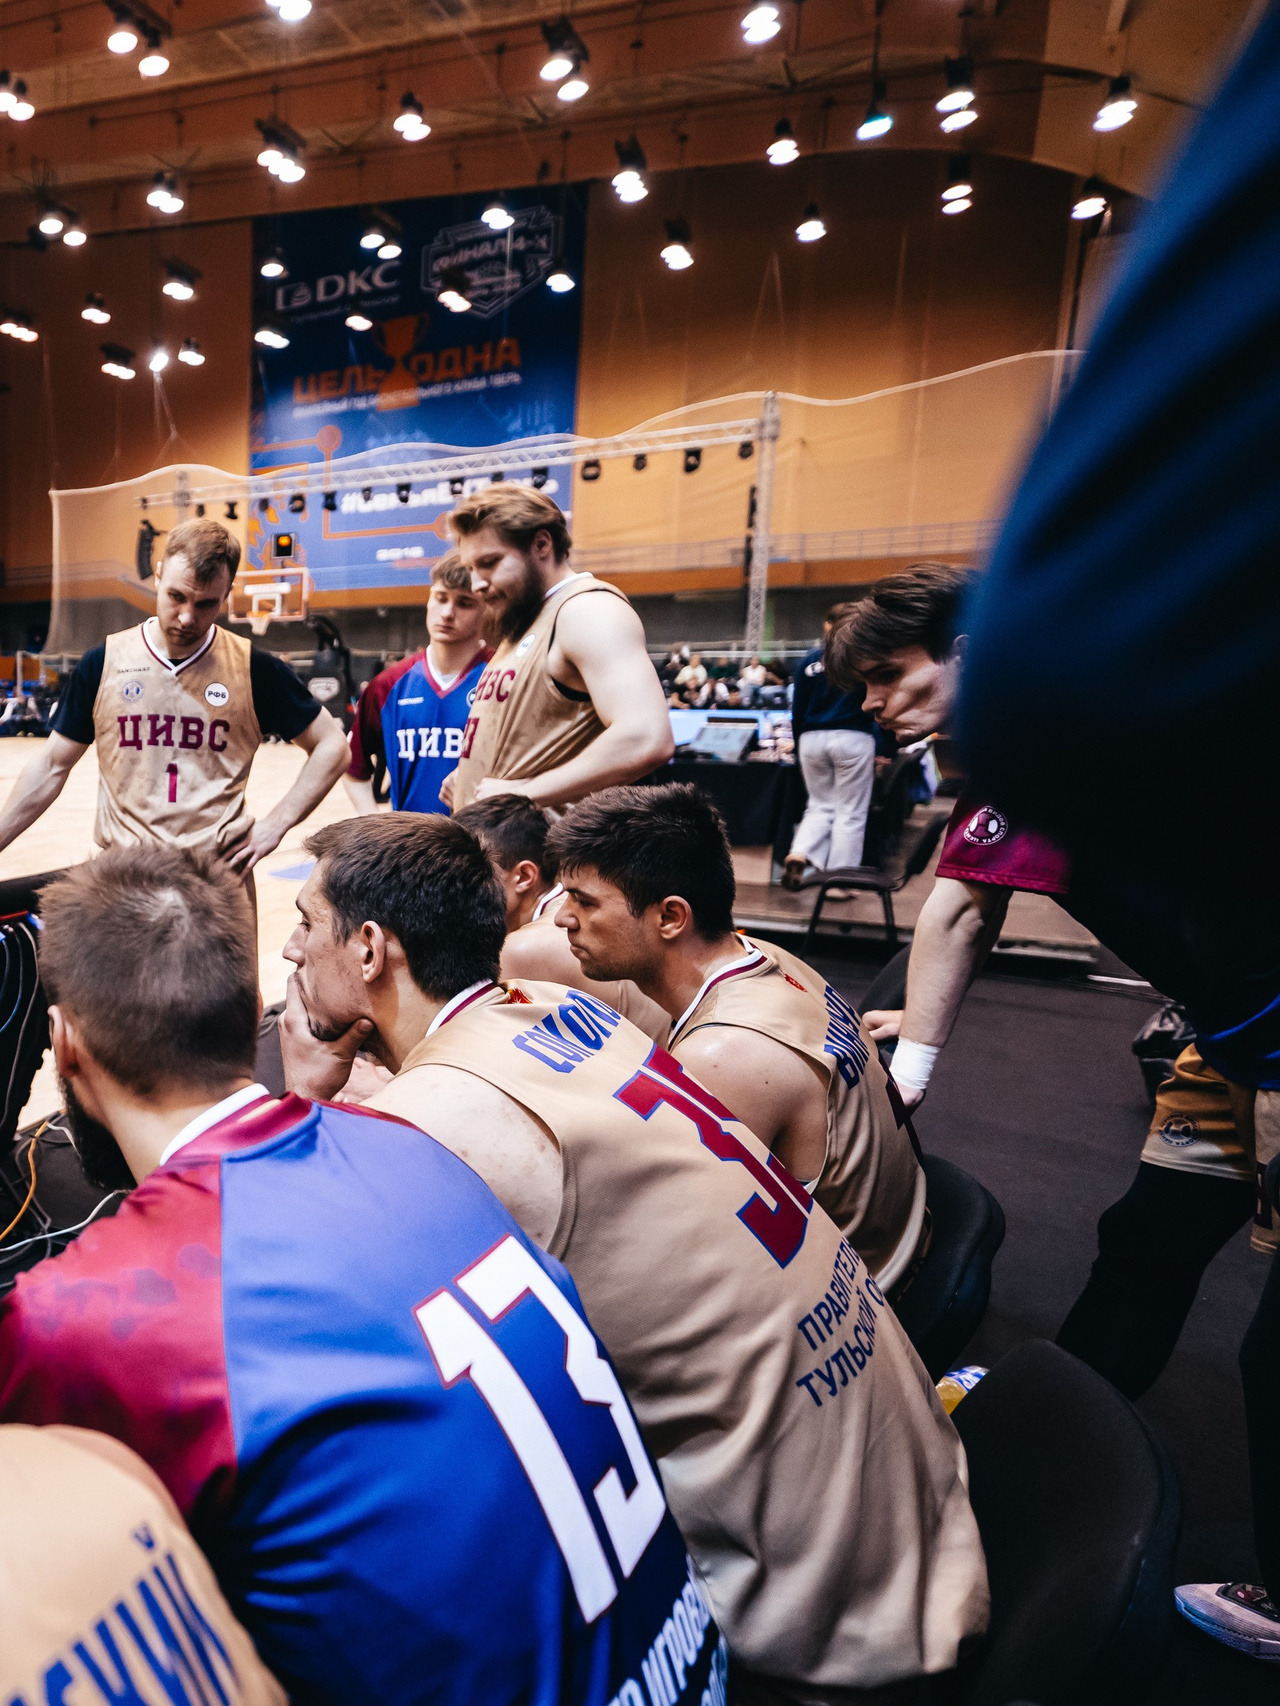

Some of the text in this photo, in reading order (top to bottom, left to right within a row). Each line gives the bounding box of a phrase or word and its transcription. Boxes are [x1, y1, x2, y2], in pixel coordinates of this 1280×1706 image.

[317, 260, 400, 301] DKC
[293, 337, 521, 404] ЦЕЛЬ ОДНА
[208, 690, 226, 699] РФБ
[117, 714, 230, 752] ЦИВС
[165, 763, 178, 803] 1
[796, 1285, 878, 1408] ТУЛЬСКОЙ
[411, 1232, 667, 1624] 13
